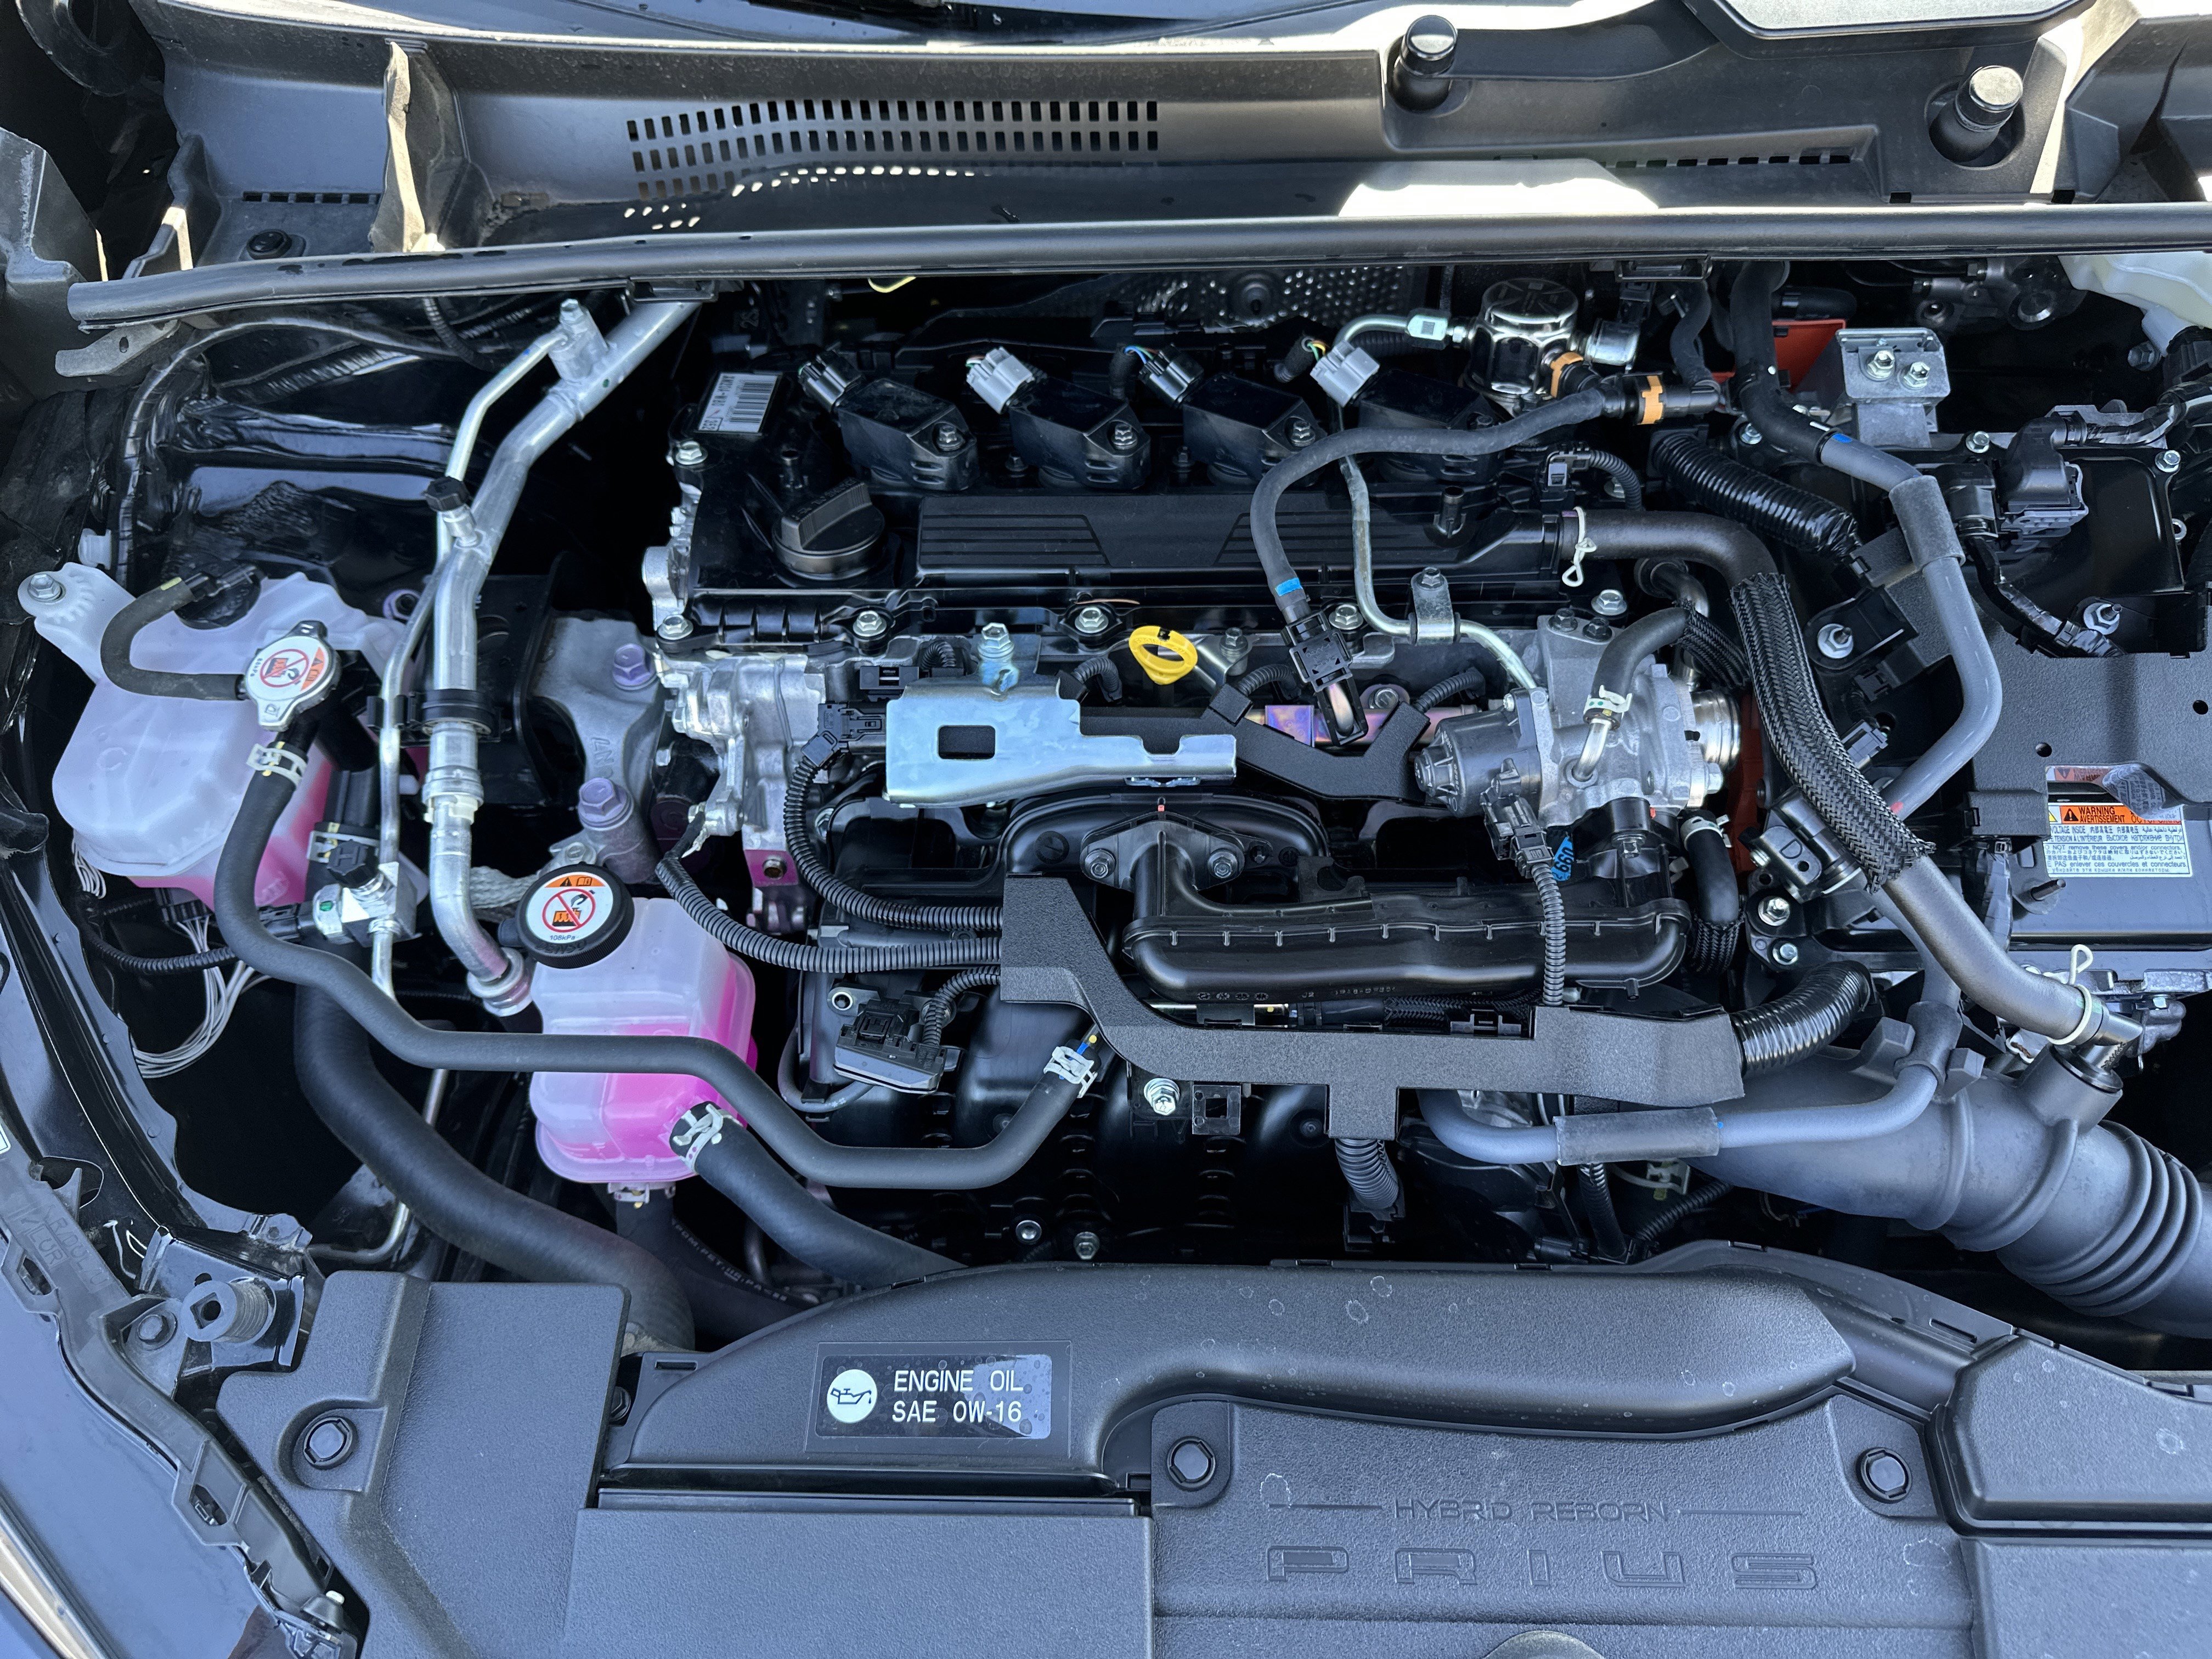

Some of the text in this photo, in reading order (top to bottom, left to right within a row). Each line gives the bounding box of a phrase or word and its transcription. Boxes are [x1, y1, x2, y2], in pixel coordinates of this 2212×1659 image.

[2079, 806, 2115, 815] WARNING
[894, 1370, 1024, 1392] ENGINE OIL
[891, 1401, 1022, 1423] SAE 0W-16
[1393, 1498, 1668, 1523] HYBRID REBORN
[1267, 1545, 1818, 1590] PRIUS
